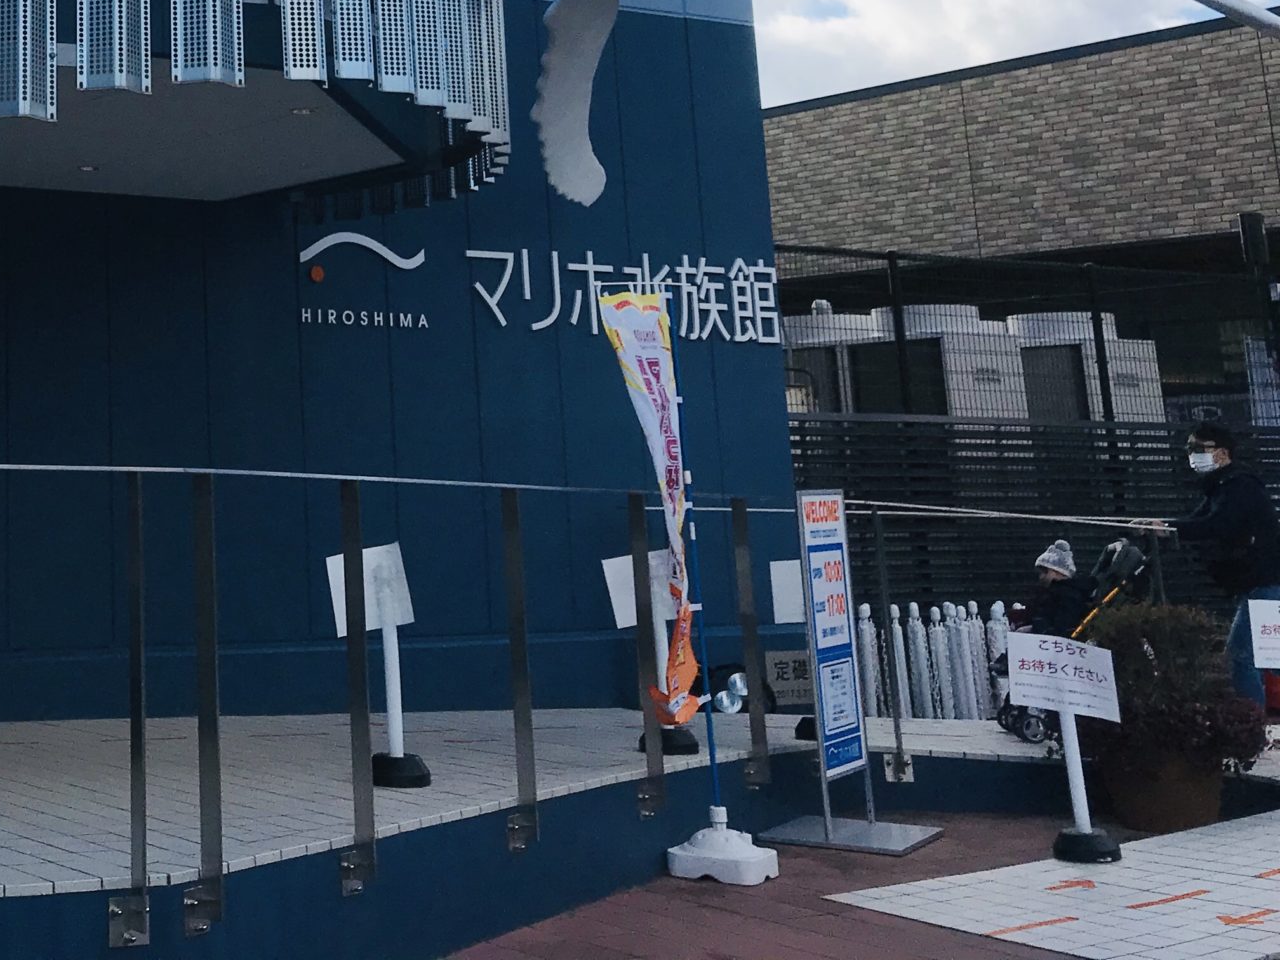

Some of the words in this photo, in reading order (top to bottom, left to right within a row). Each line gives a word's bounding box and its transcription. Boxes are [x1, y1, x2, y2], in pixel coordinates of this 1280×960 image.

[301, 307, 429, 329] HIROSHIMA
[823, 559, 843, 583] 10:00
[827, 593, 846, 617] 17:00
[1038, 639, 1088, 659] こちらで
[1017, 657, 1108, 684] お待ちください
